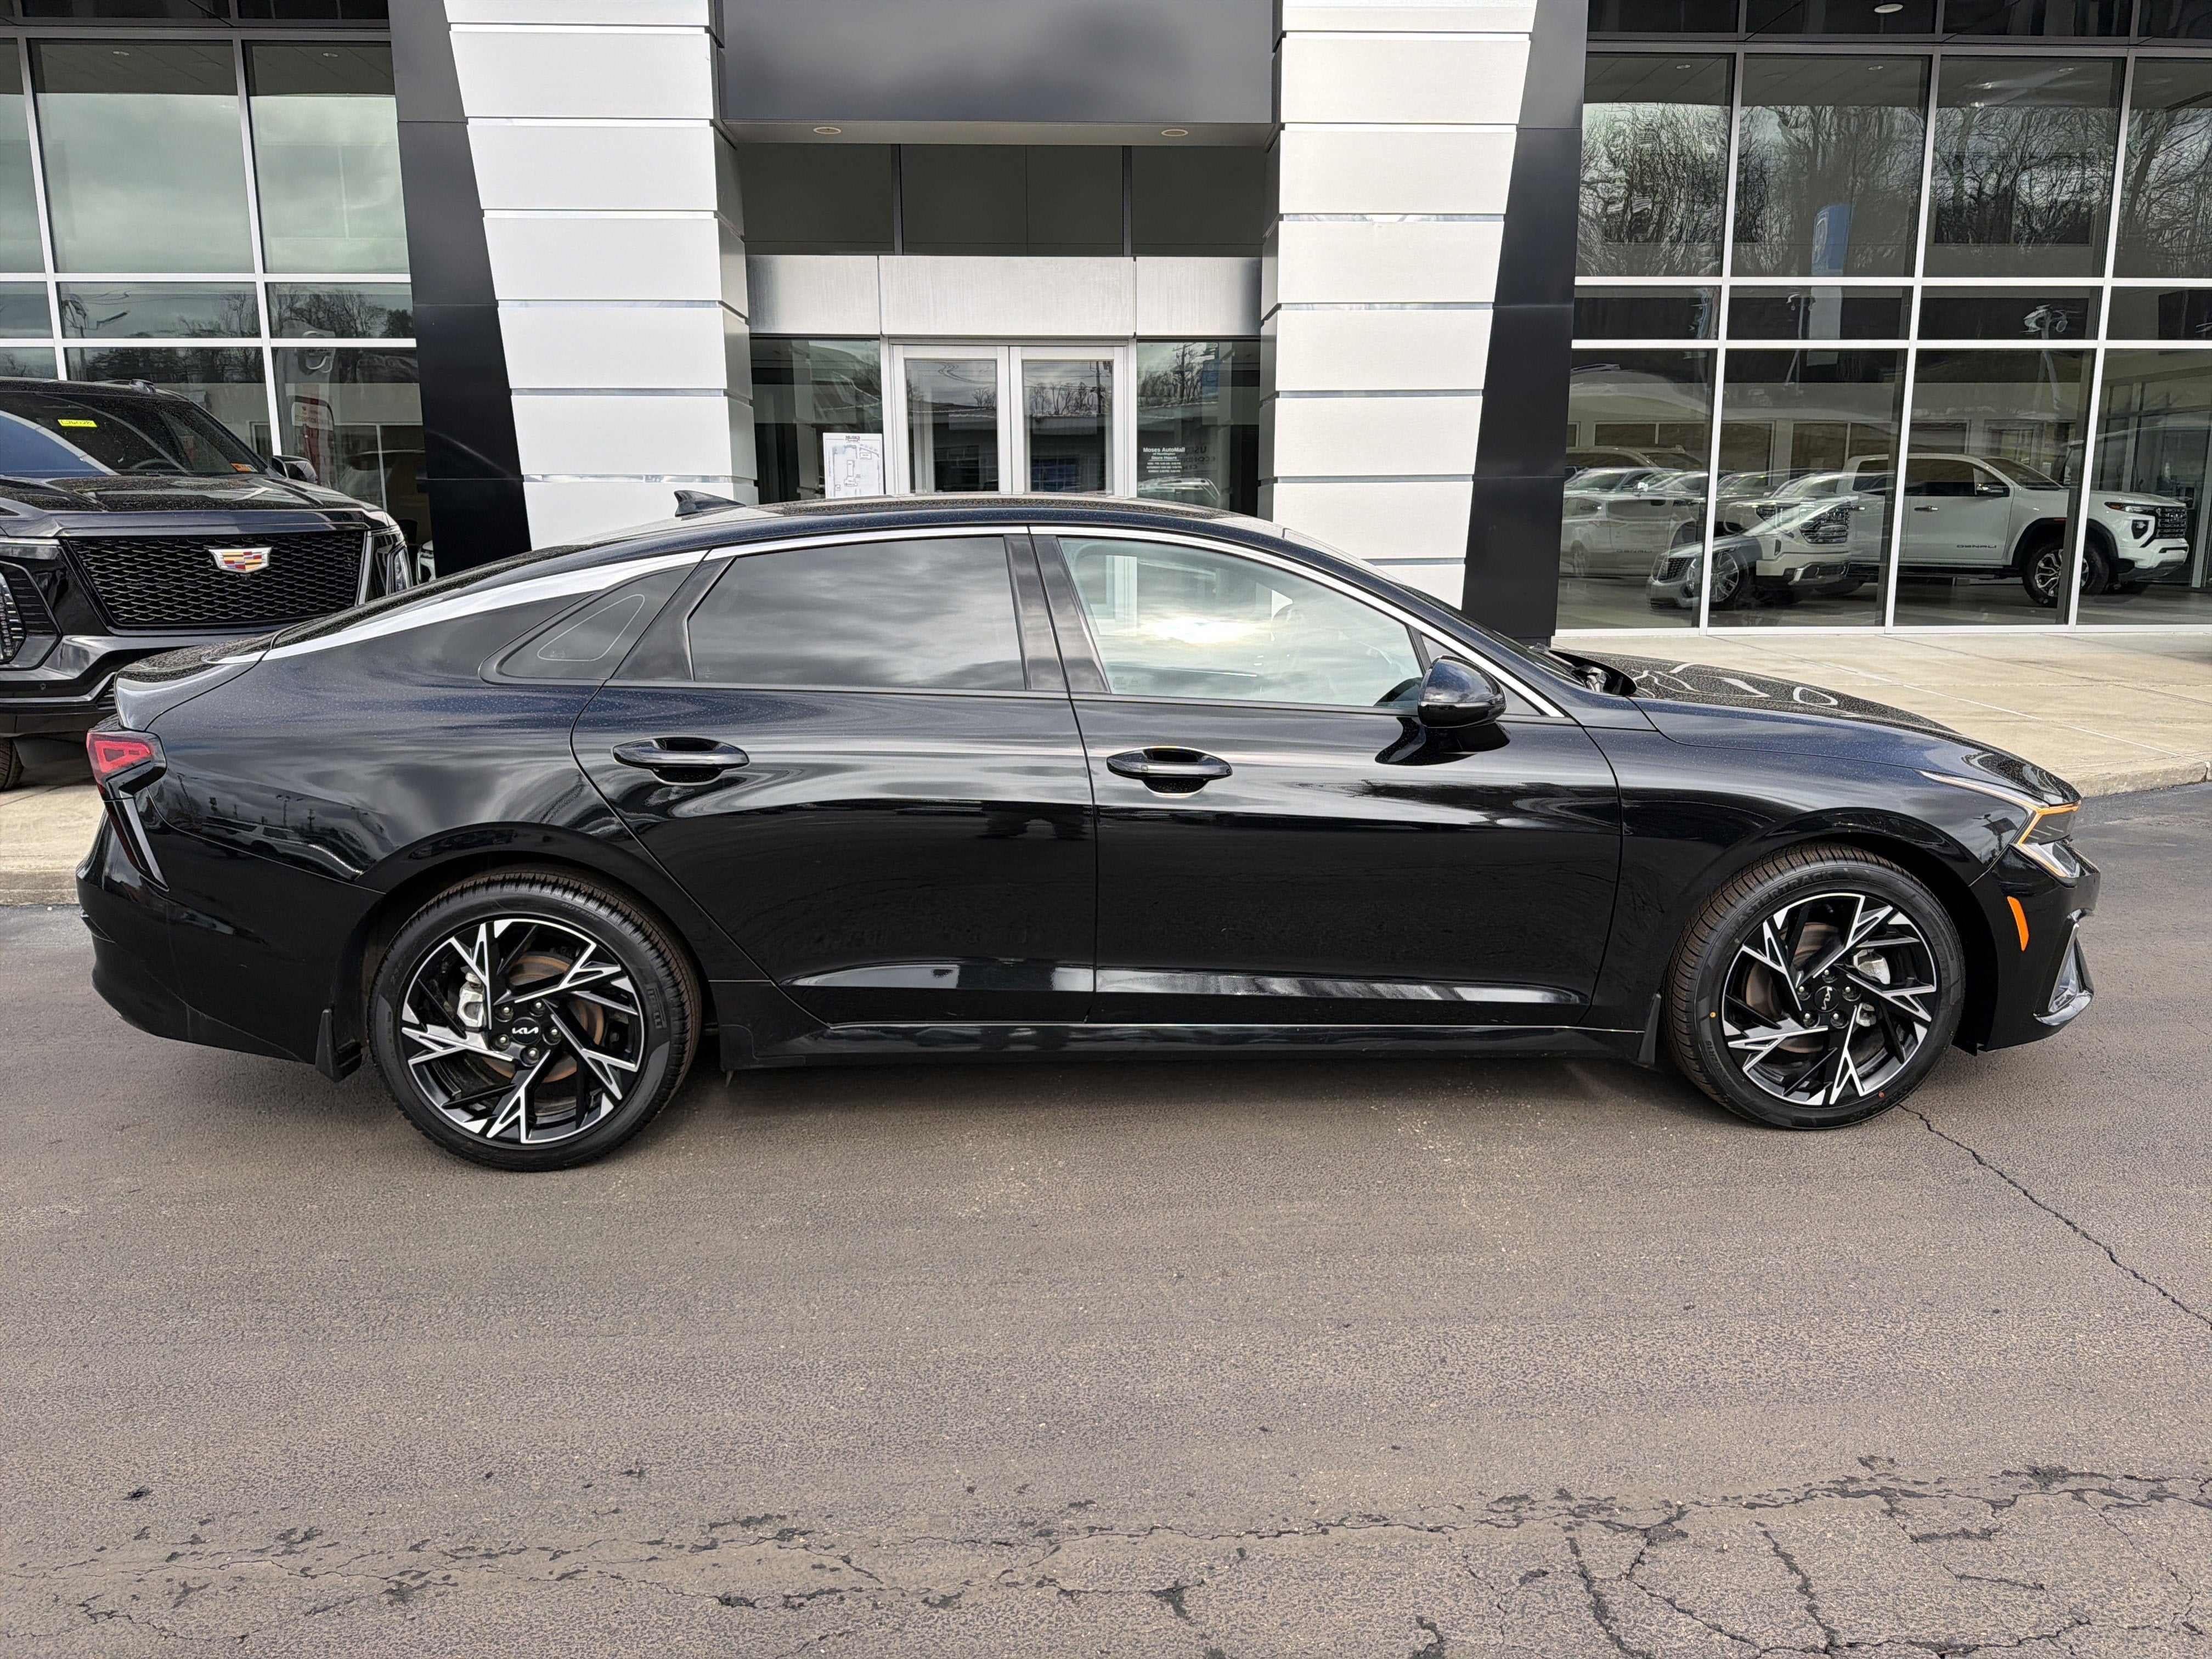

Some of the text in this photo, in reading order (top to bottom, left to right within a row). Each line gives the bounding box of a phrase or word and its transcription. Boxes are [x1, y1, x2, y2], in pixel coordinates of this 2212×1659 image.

[561, 903, 600, 922] OUTSIDE
[1727, 870, 1832, 937] MASTERTRACK
[645, 983, 668, 1029] PIRELLI
[512, 1026, 539, 1035] KIA
